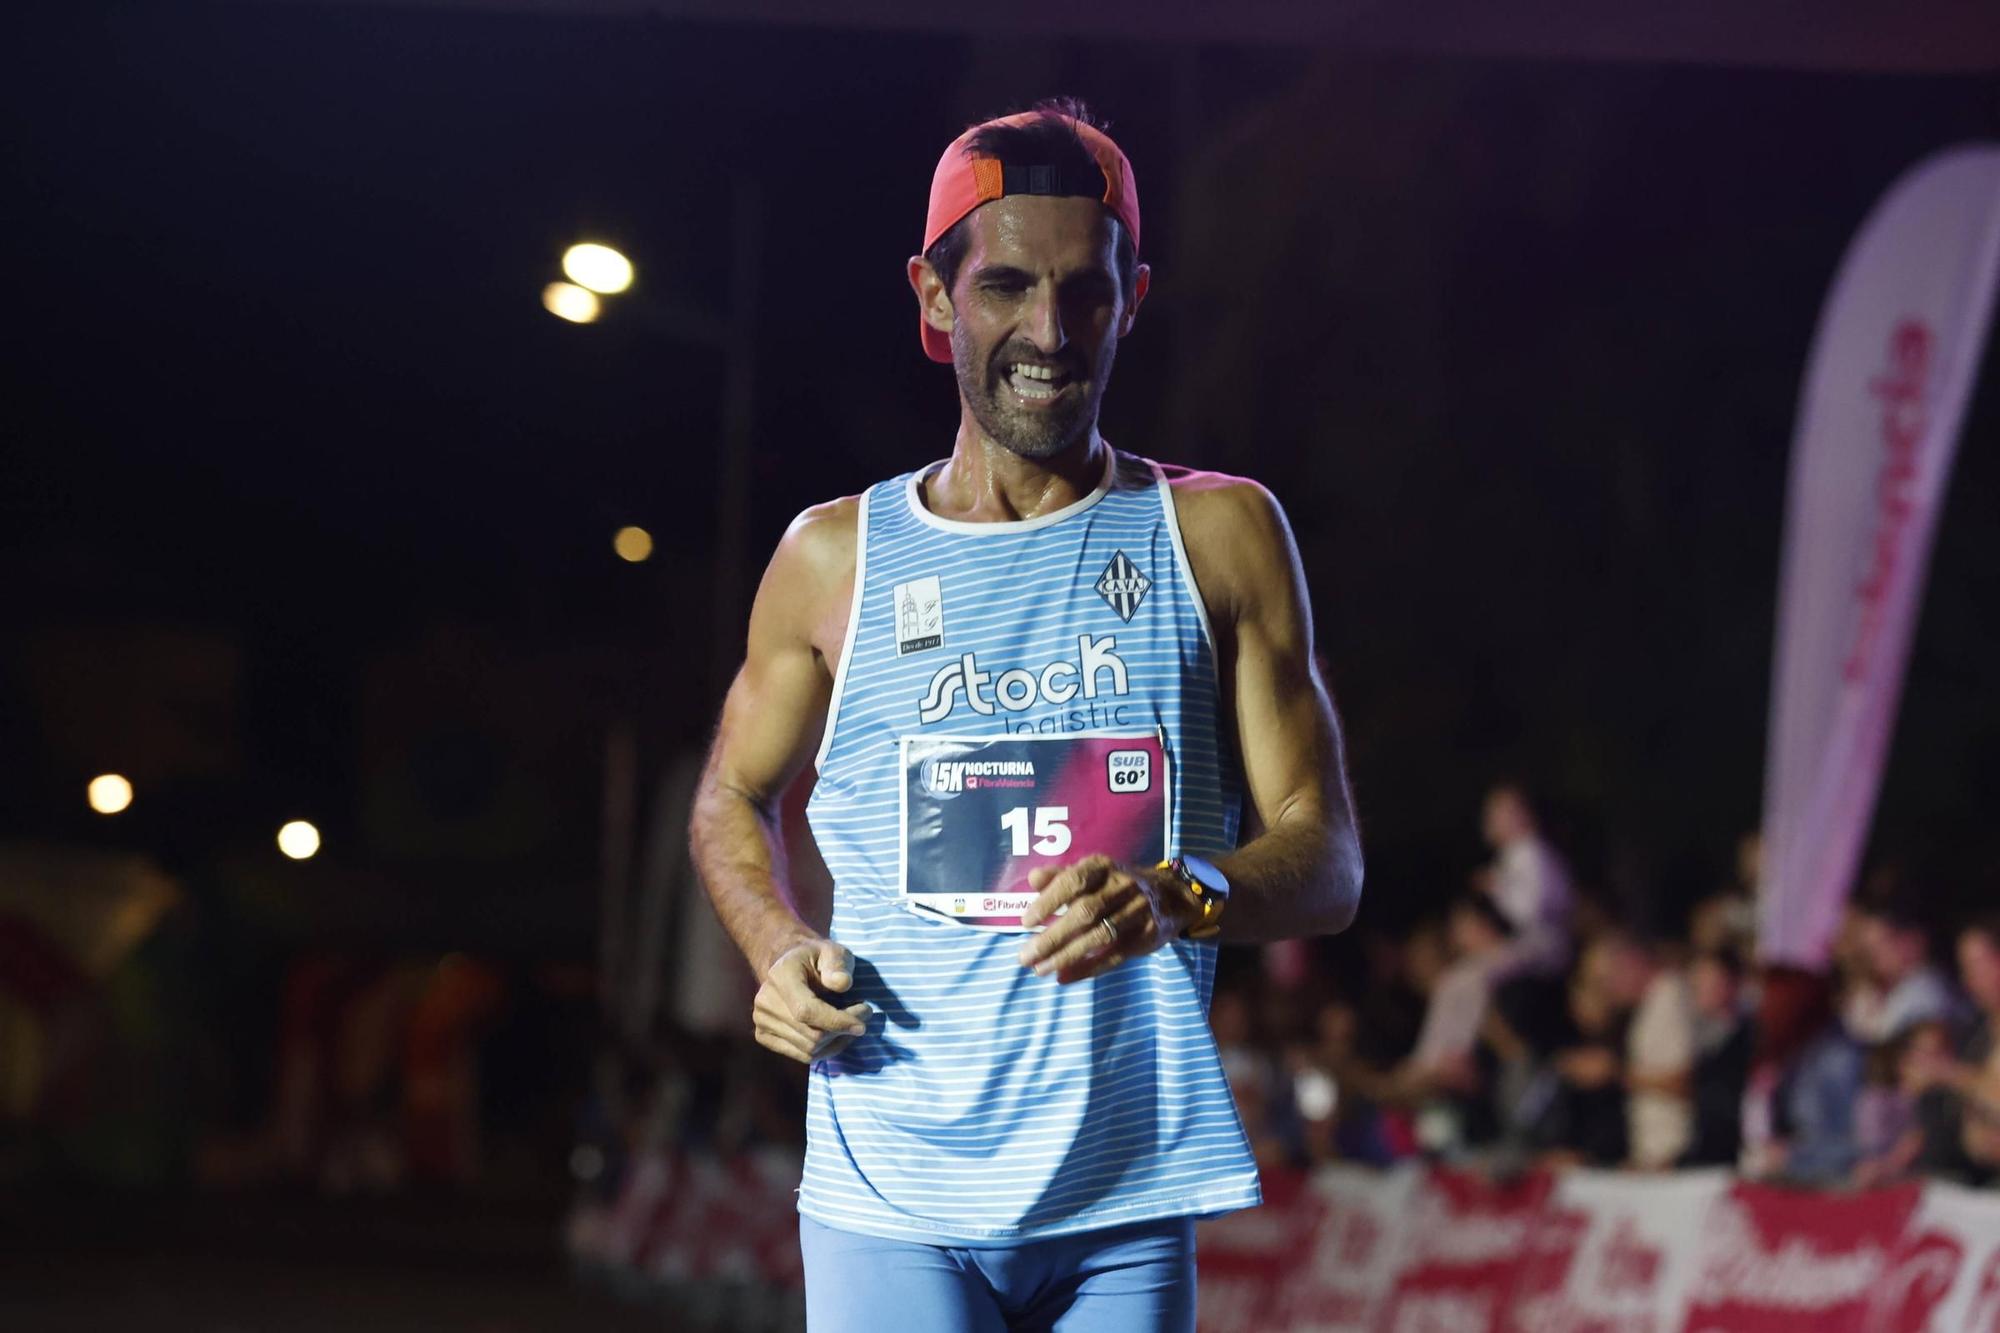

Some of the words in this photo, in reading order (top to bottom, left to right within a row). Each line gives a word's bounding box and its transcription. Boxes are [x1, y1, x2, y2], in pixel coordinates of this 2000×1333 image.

[918, 633, 1130, 726] stock
[929, 762, 966, 792] 15K
[965, 761, 1035, 776] NOCTURNA
[1113, 755, 1145, 767] SUB
[1001, 805, 1072, 857] 15
